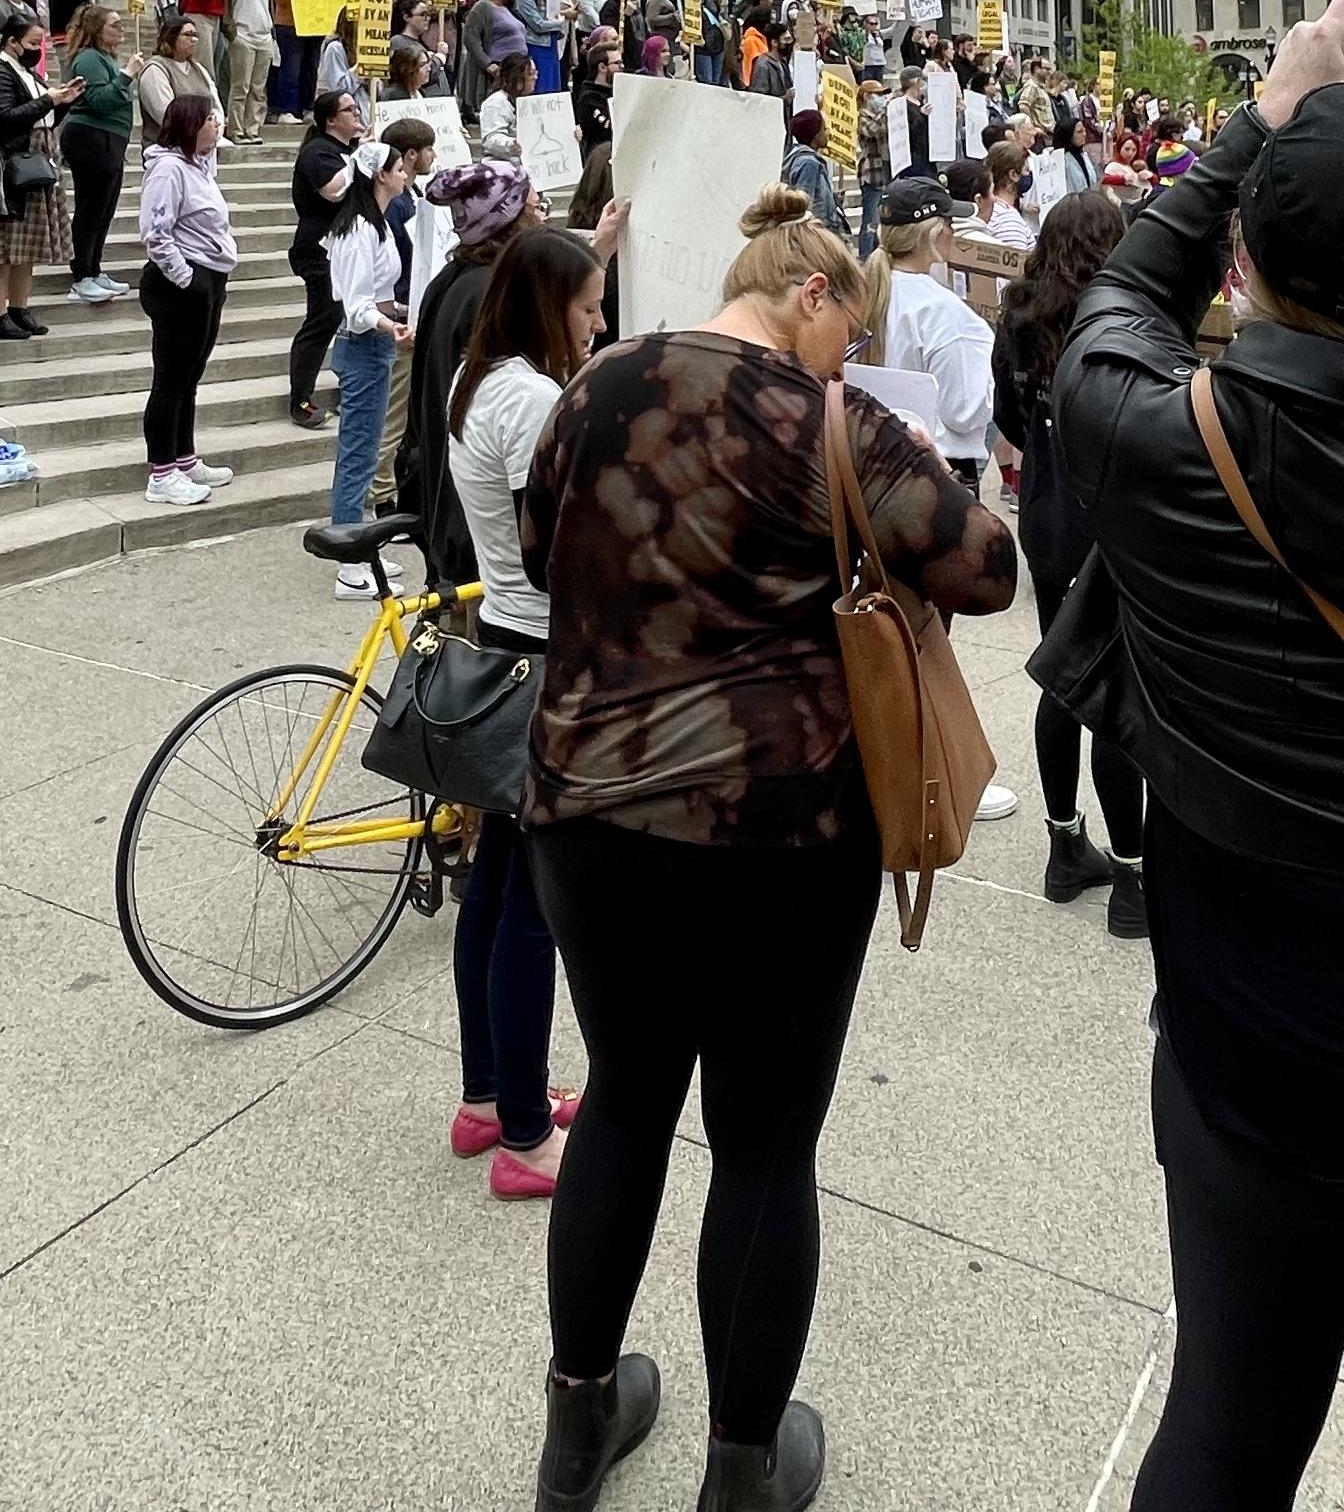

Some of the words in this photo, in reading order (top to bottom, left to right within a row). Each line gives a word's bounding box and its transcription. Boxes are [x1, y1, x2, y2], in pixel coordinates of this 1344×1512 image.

[1210, 37, 1267, 50] ambrose
[546, 99, 564, 112] not
[546, 155, 570, 176] back
